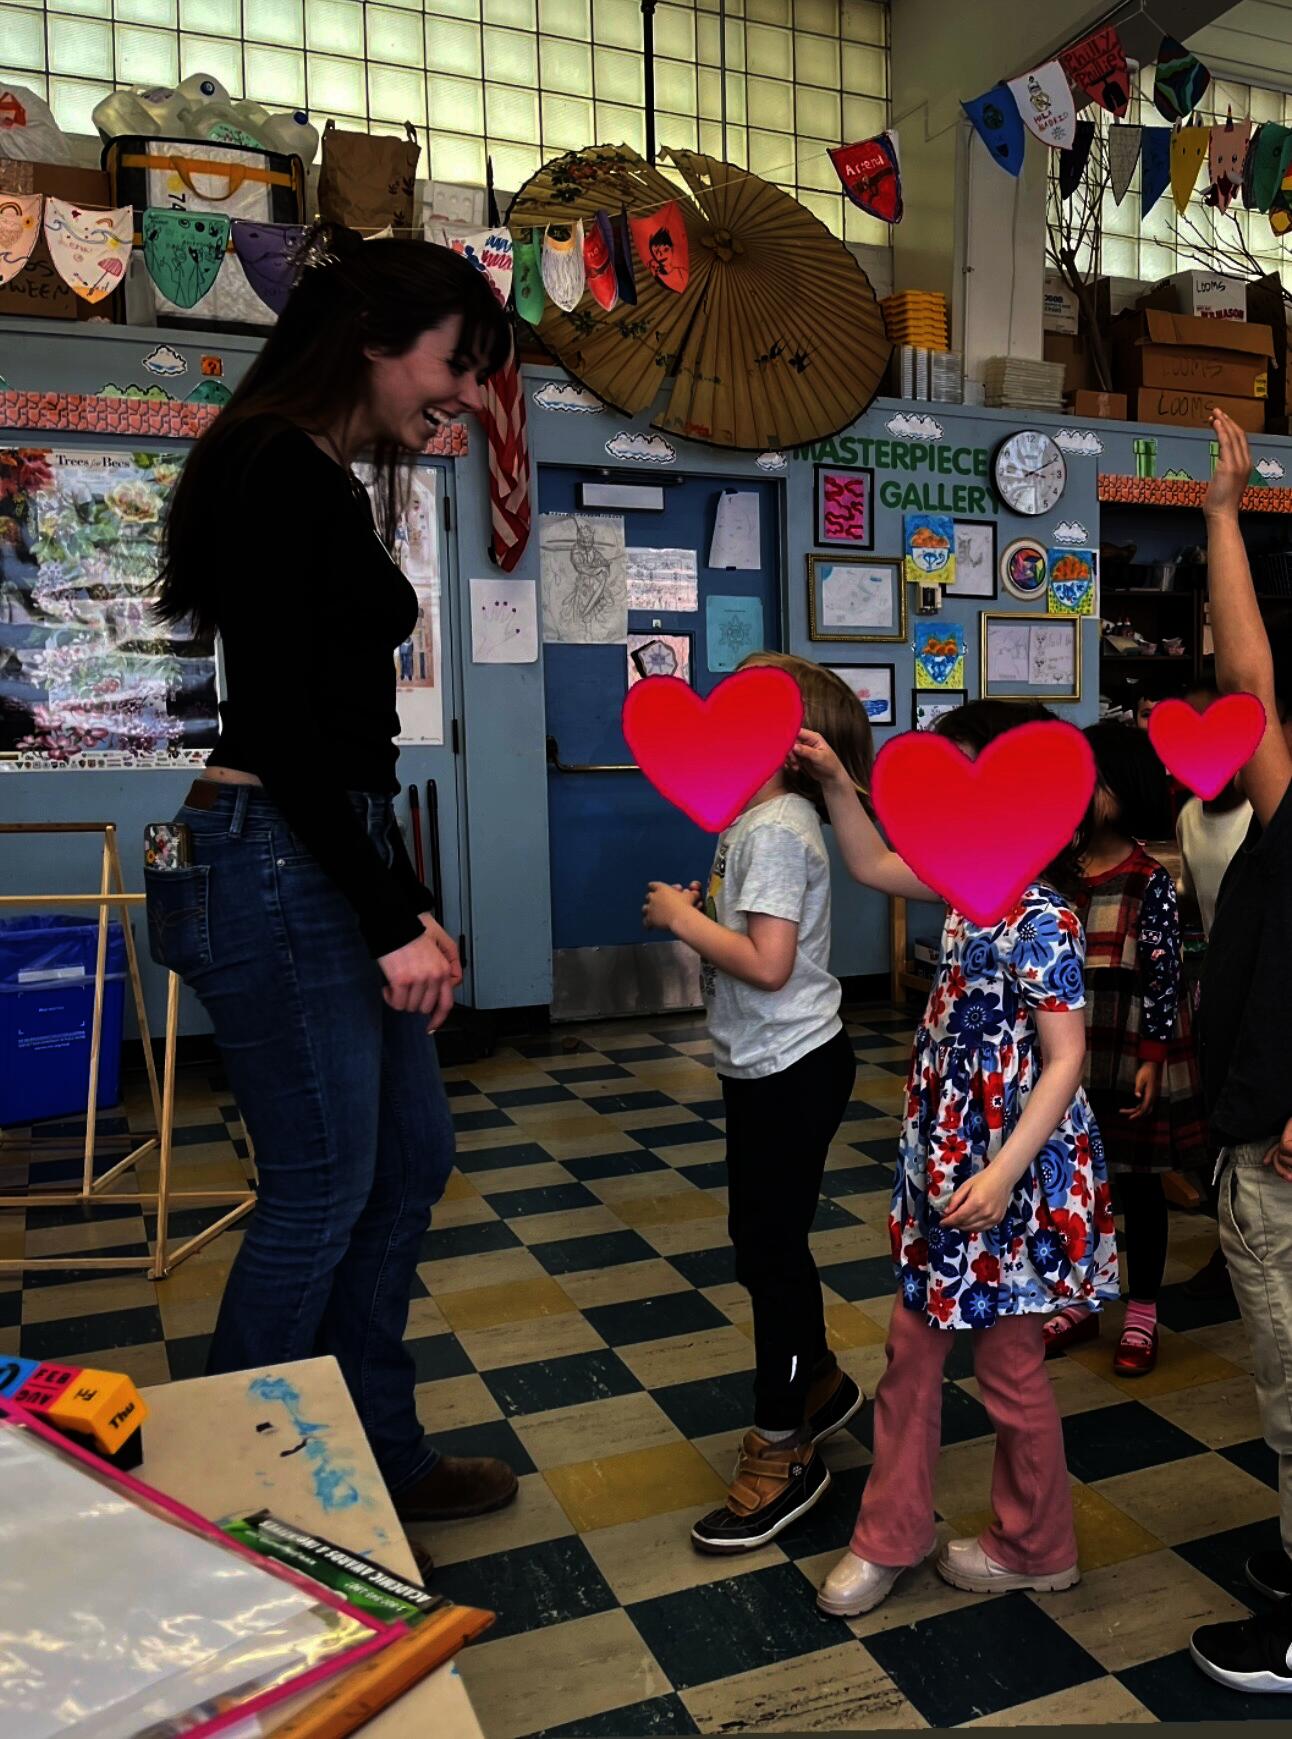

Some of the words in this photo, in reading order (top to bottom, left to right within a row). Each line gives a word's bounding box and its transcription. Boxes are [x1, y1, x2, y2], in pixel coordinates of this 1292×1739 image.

[1065, 30, 1113, 66] Philly
[1196, 280, 1226, 293] LOOMS
[1158, 391, 1214, 416] LOOMS
[56, 454, 89, 466] Trees
[103, 456, 130, 467] Bees
[793, 436, 988, 477] MASTERPIECE
[1057, 470, 1062, 479] 3
[880, 480, 999, 515] GALLERY
[33, 1369, 71, 1384] FEB
[15, 1390, 52, 1405] AUG
[108, 1402, 135, 1429] Thu
[324, 1550, 371, 1576] AWARDS
[369, 1571, 433, 1603] ACADEMIC
